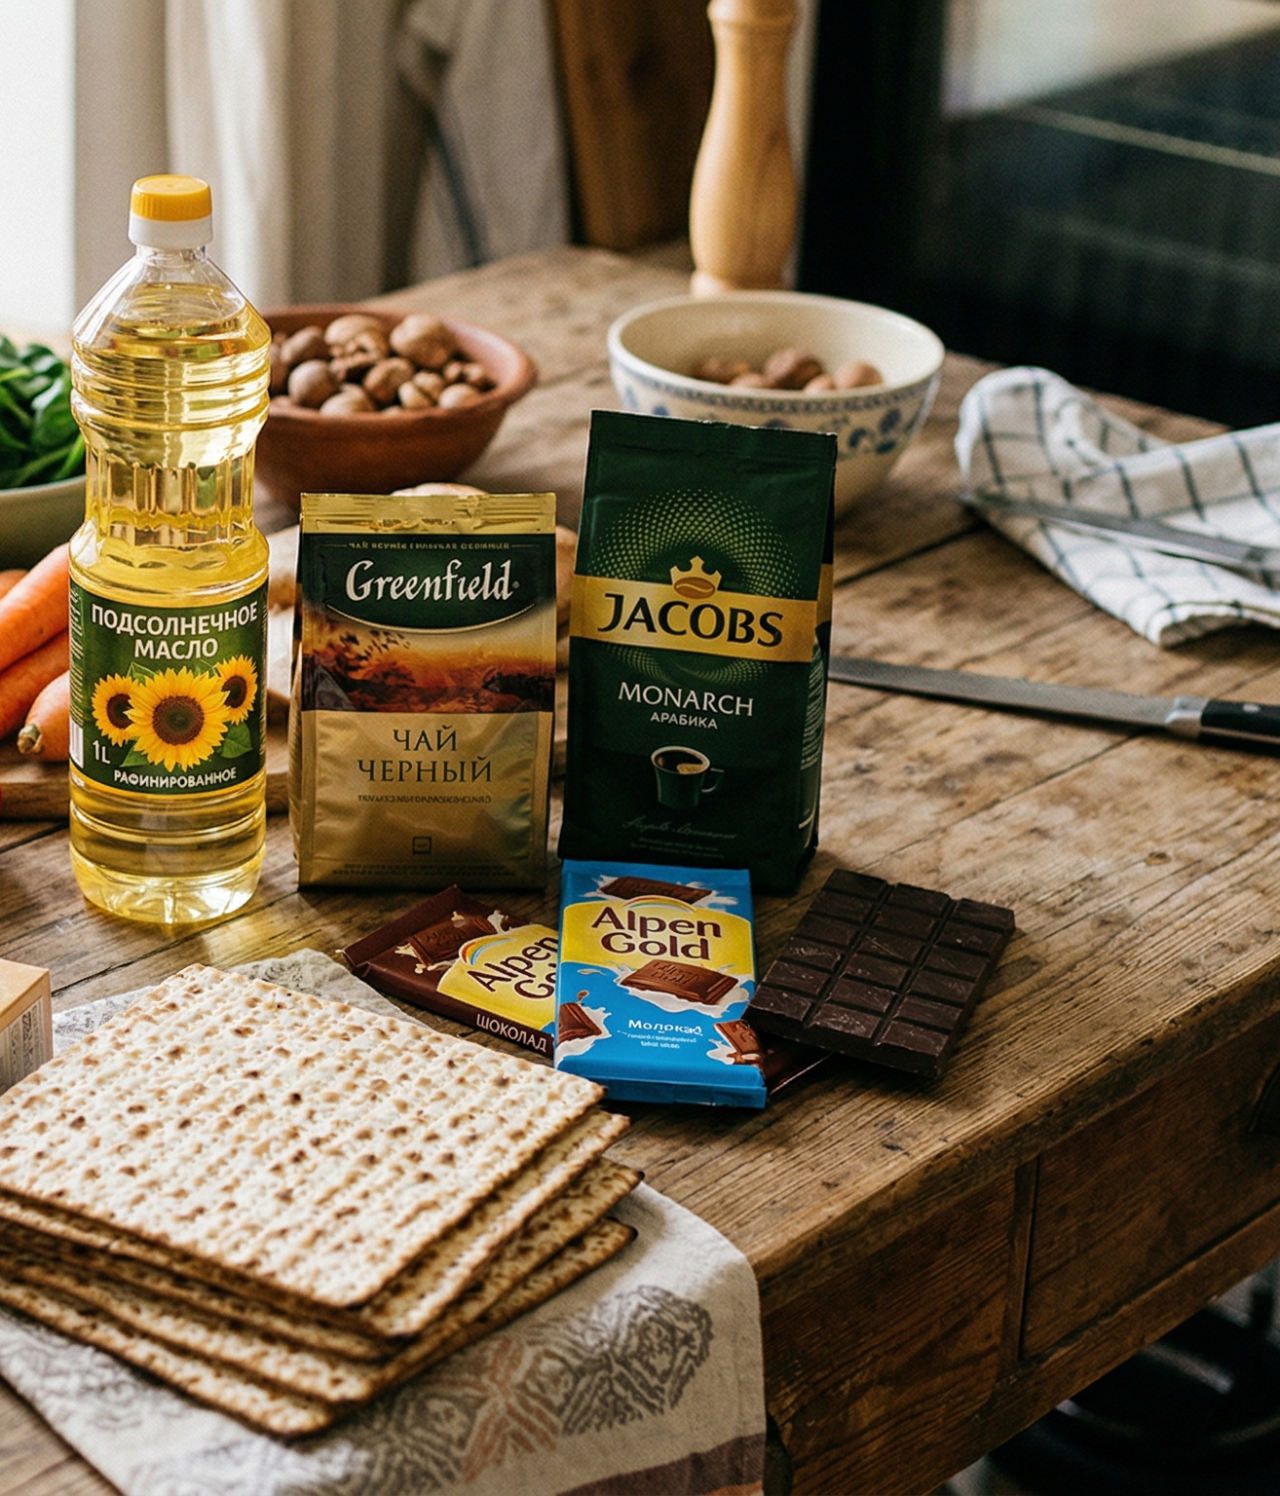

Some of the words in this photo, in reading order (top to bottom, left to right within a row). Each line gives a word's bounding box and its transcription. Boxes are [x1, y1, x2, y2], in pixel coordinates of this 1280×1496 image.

[345, 558, 514, 601] Greenfield
[91, 600, 259, 636] ПОДСОЛНЕЧНОЕ
[597, 593, 784, 647] JACOBS
[134, 638, 219, 660] МАСЛО
[617, 681, 754, 717] MONARCH
[650, 711, 718, 730] АРАБИКА
[92, 740, 111, 765] 1L
[392, 724, 458, 751] ЧАЙ
[114, 767, 237, 788] РАФИНИРОВАННОЕ
[357, 755, 492, 783] ЧЕРНЫЙ
[591, 906, 722, 939] Alpen
[600, 932, 711, 961] Gold
[467, 937, 559, 993] Alpen
[476, 1013, 548, 1052] ШОКОЛАД
